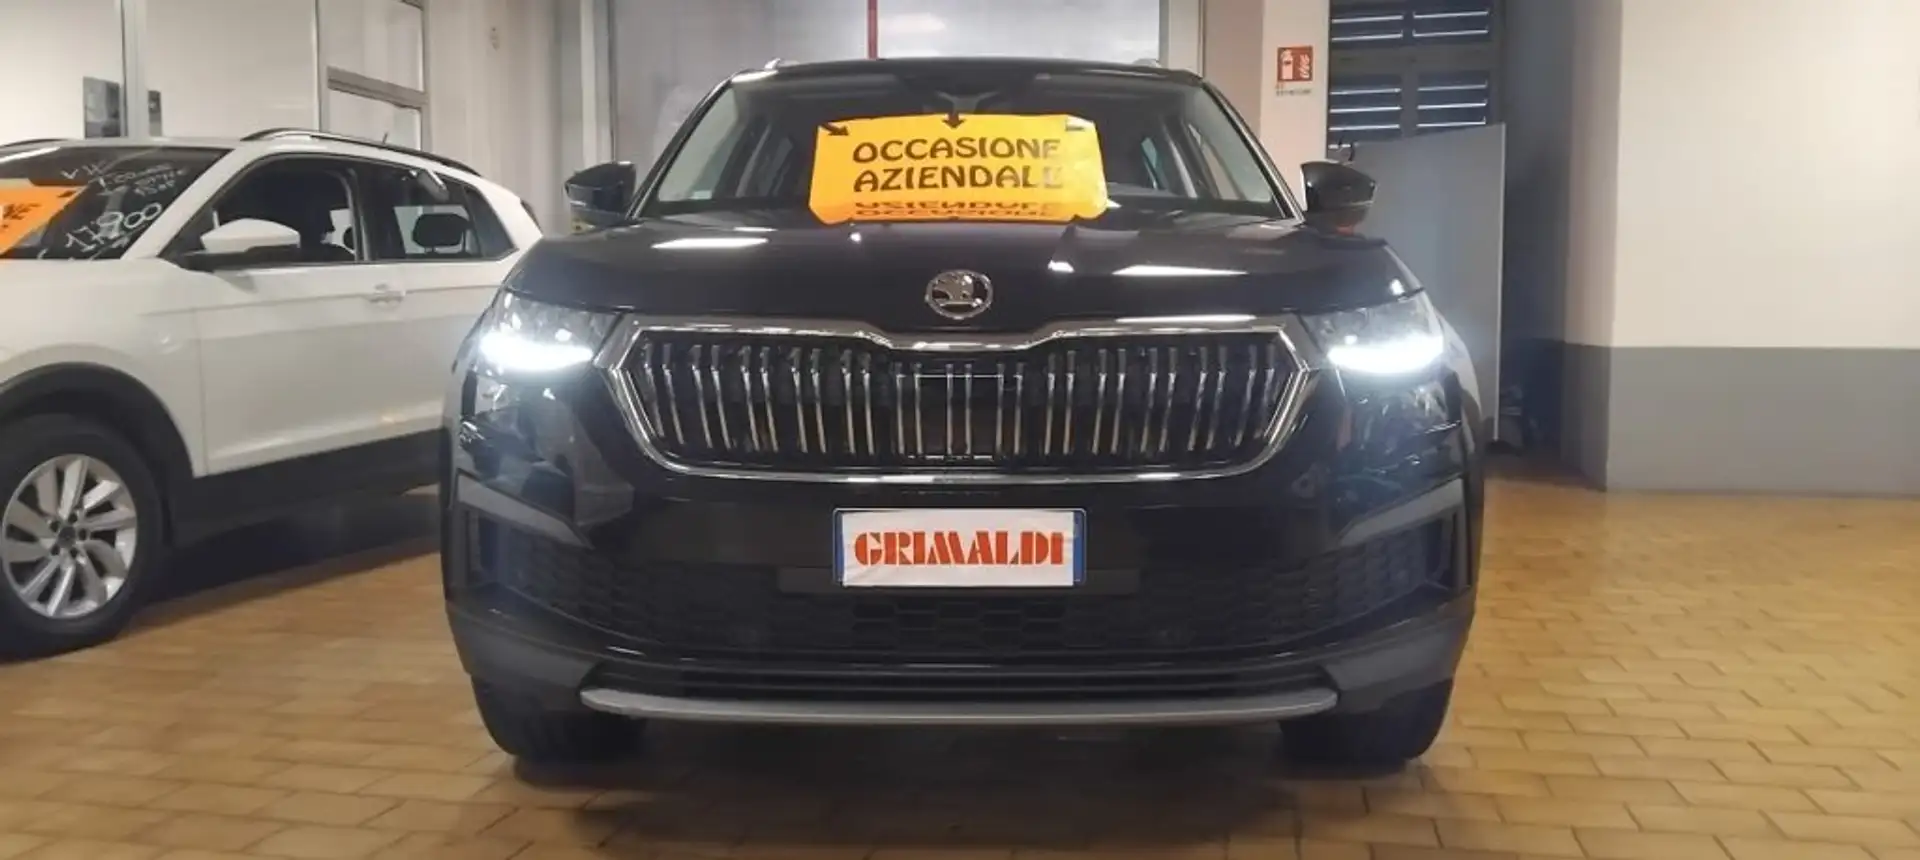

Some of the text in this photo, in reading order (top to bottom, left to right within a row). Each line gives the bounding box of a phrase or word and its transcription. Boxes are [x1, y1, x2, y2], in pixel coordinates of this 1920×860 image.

[853, 137, 1061, 163] OCCASIONE
[854, 165, 1064, 192] AZIENDALE
[854, 531, 1064, 566] GRIMALDI
